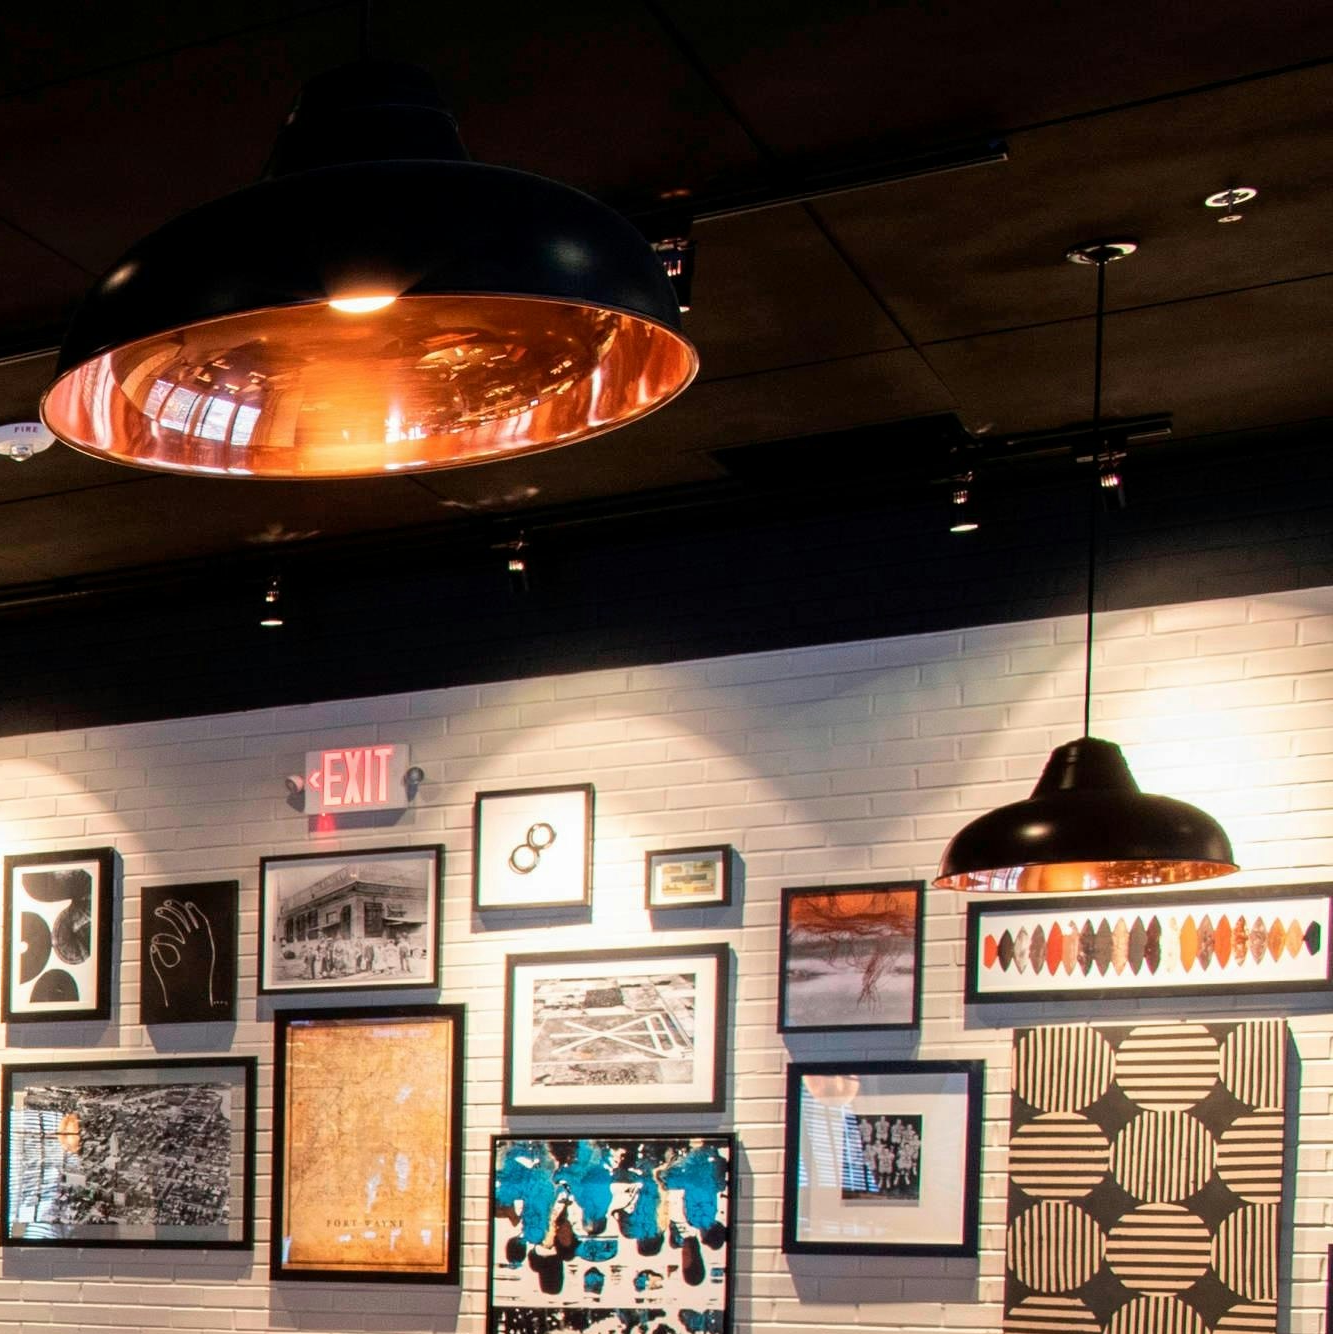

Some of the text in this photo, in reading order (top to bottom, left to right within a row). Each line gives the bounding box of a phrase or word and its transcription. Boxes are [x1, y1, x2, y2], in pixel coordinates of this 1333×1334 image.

[323, 749, 393, 806] EXIT
[326, 1219, 405, 1228] FORT WAYNE
